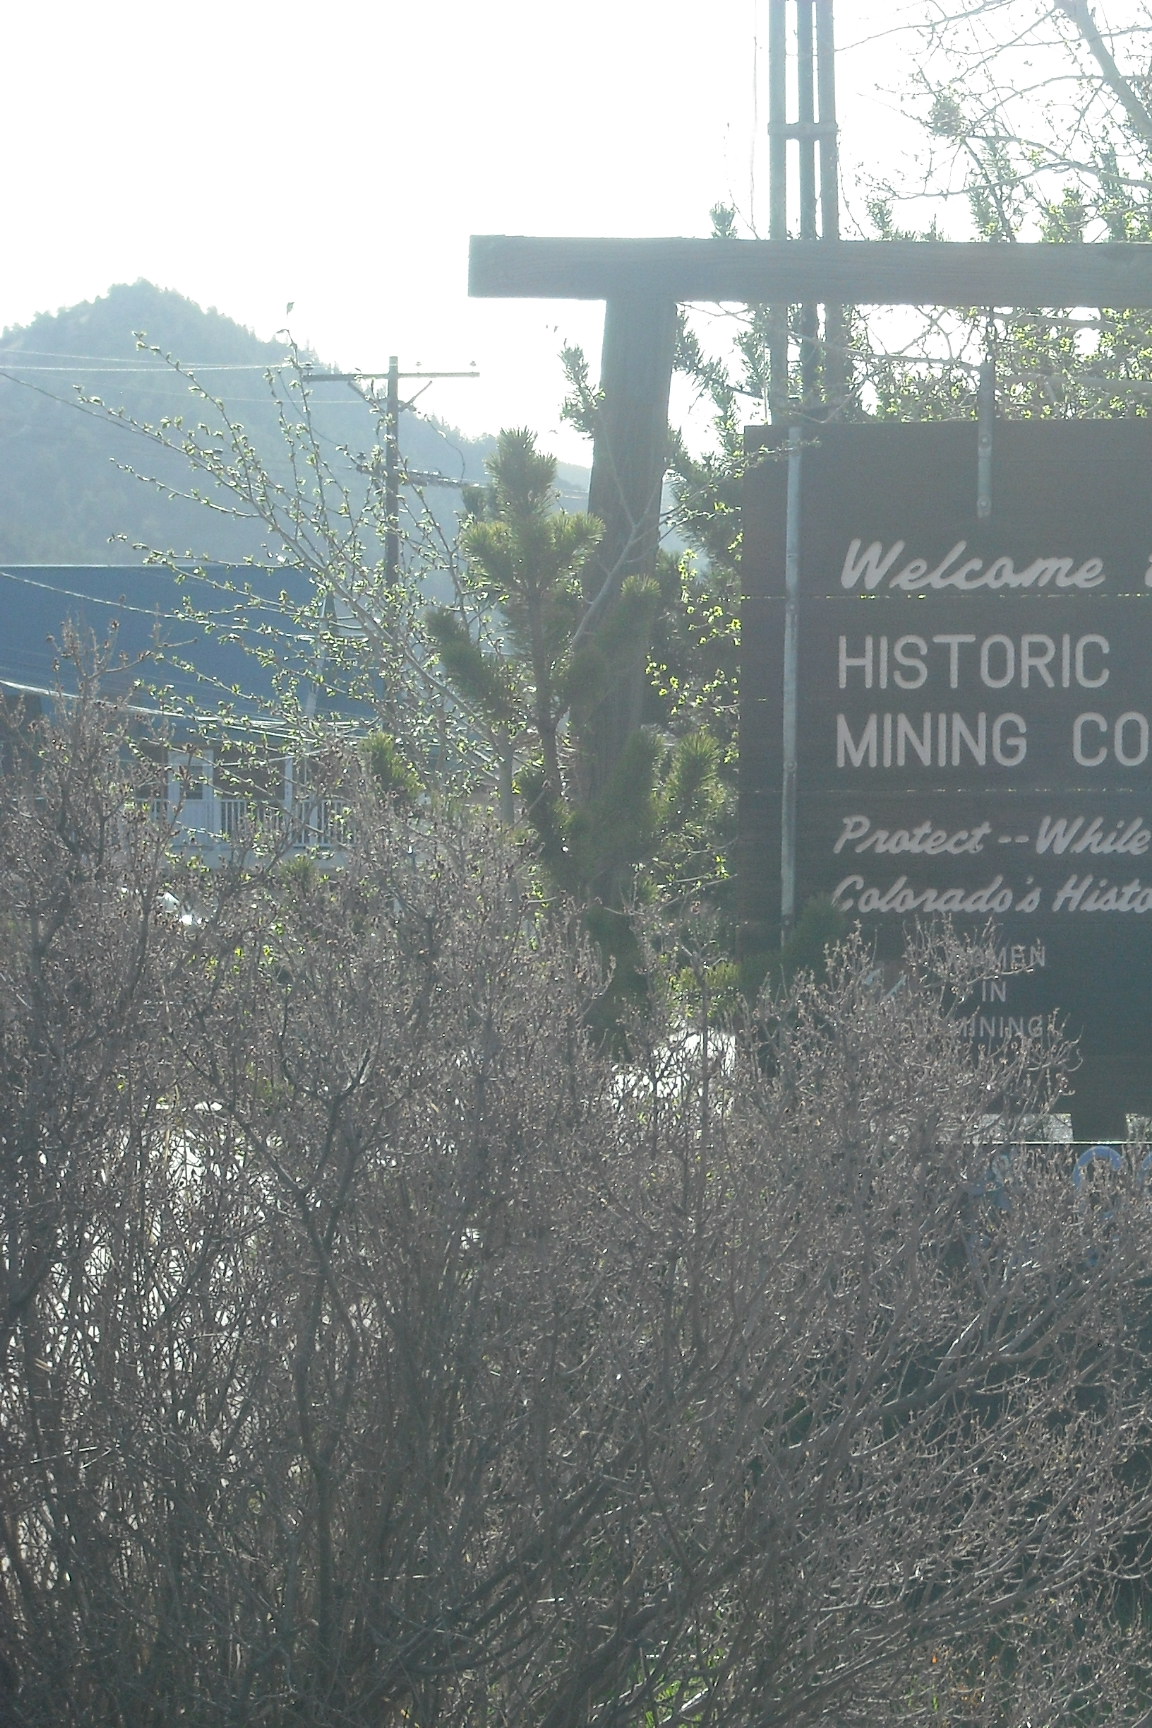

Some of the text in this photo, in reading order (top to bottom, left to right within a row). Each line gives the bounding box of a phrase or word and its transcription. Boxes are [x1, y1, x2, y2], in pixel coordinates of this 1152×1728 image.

[841, 539, 1105, 590] Welcome
[839, 634, 1110, 689] HISTORIC
[837, 712, 1027, 768] MINING
[831, 875, 1041, 913] Colorado's
[981, 980, 1007, 1002] IN
